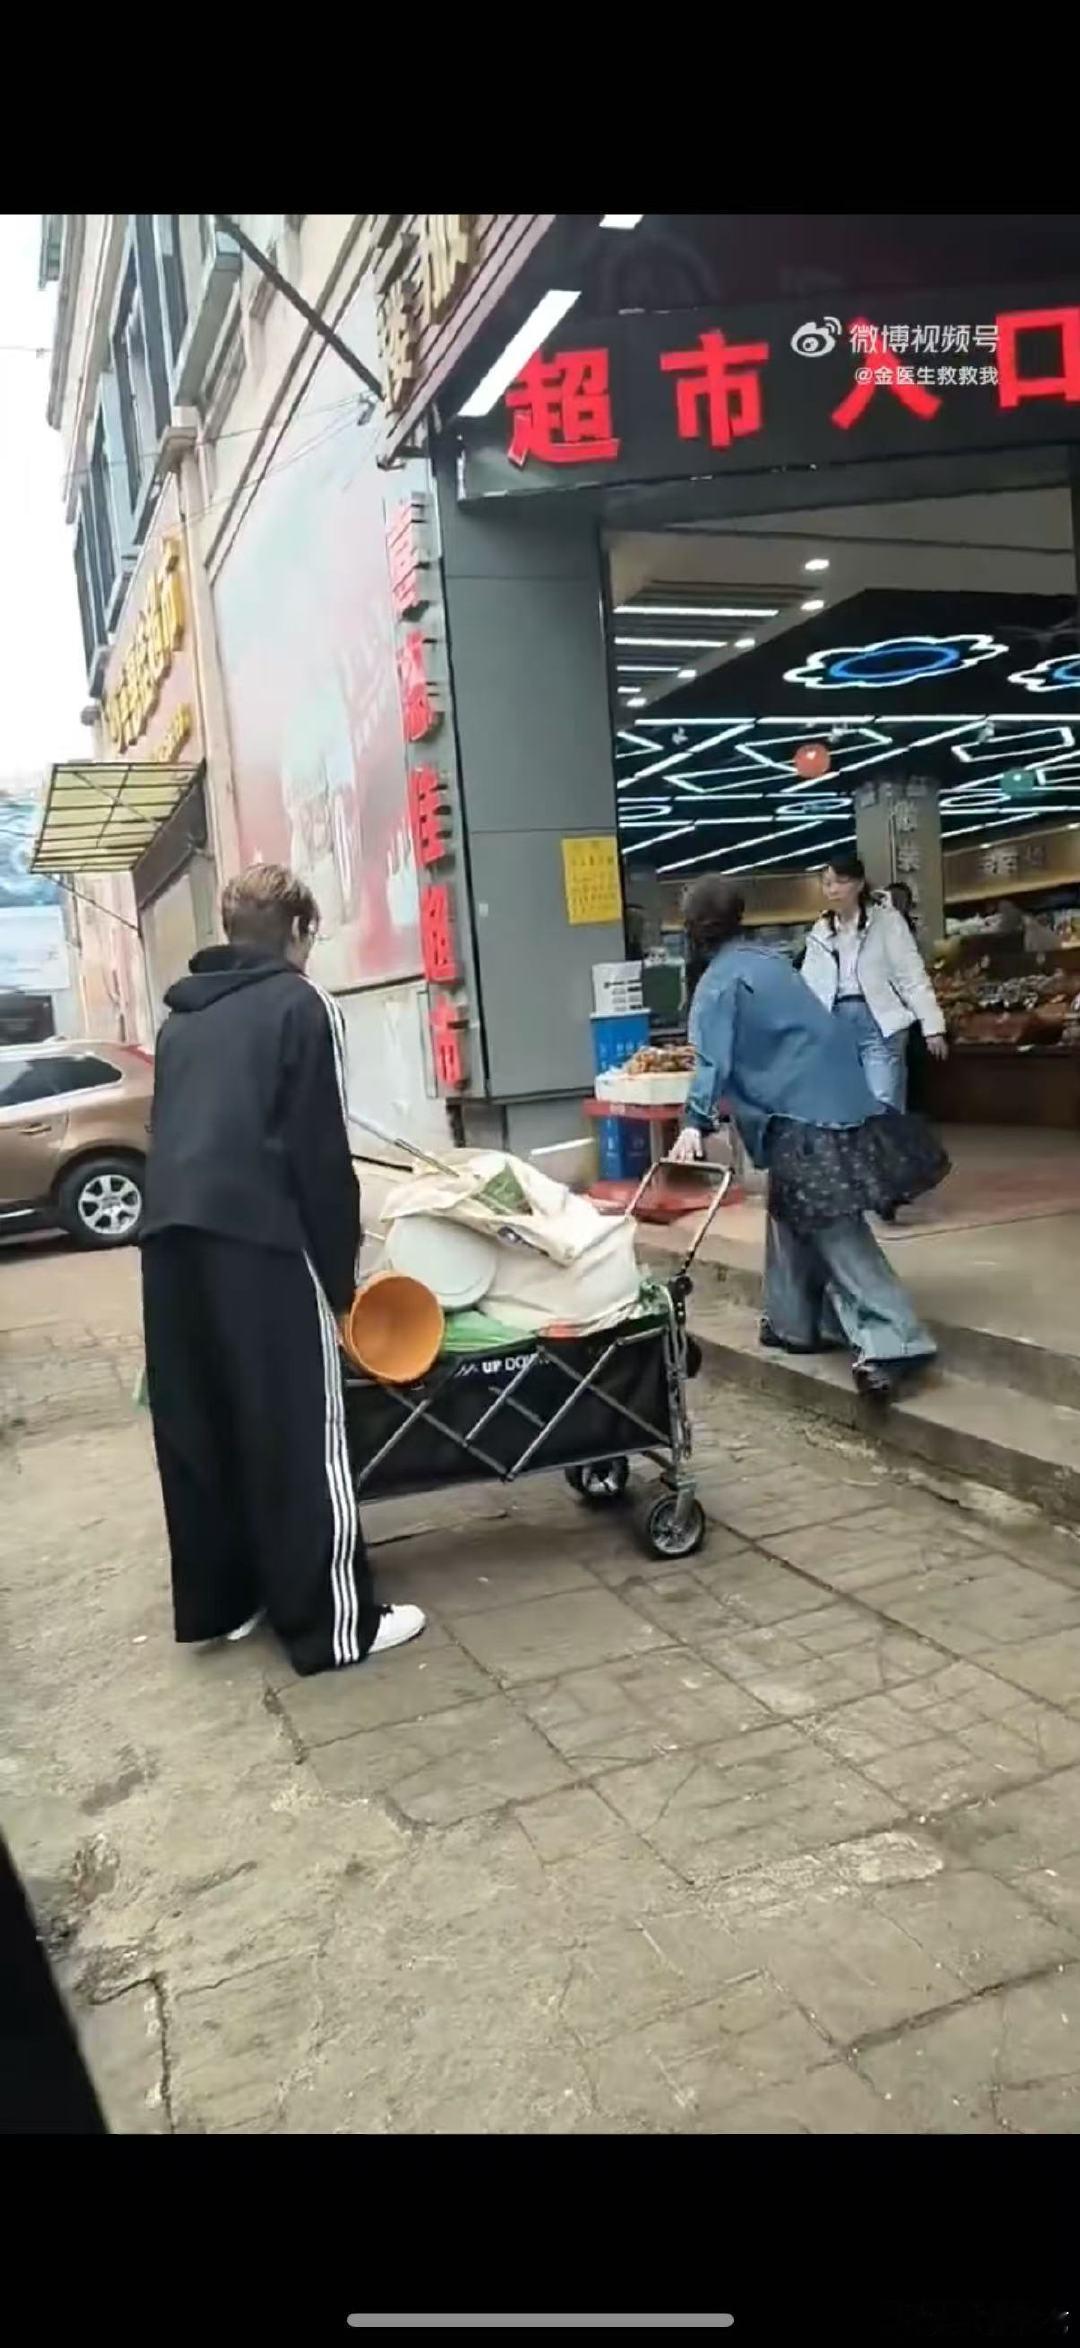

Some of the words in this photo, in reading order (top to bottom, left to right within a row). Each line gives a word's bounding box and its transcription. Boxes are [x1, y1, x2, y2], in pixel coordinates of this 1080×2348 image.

[506, 308, 1080, 466] 超市入口
[482, 1360, 502, 1374] UP
